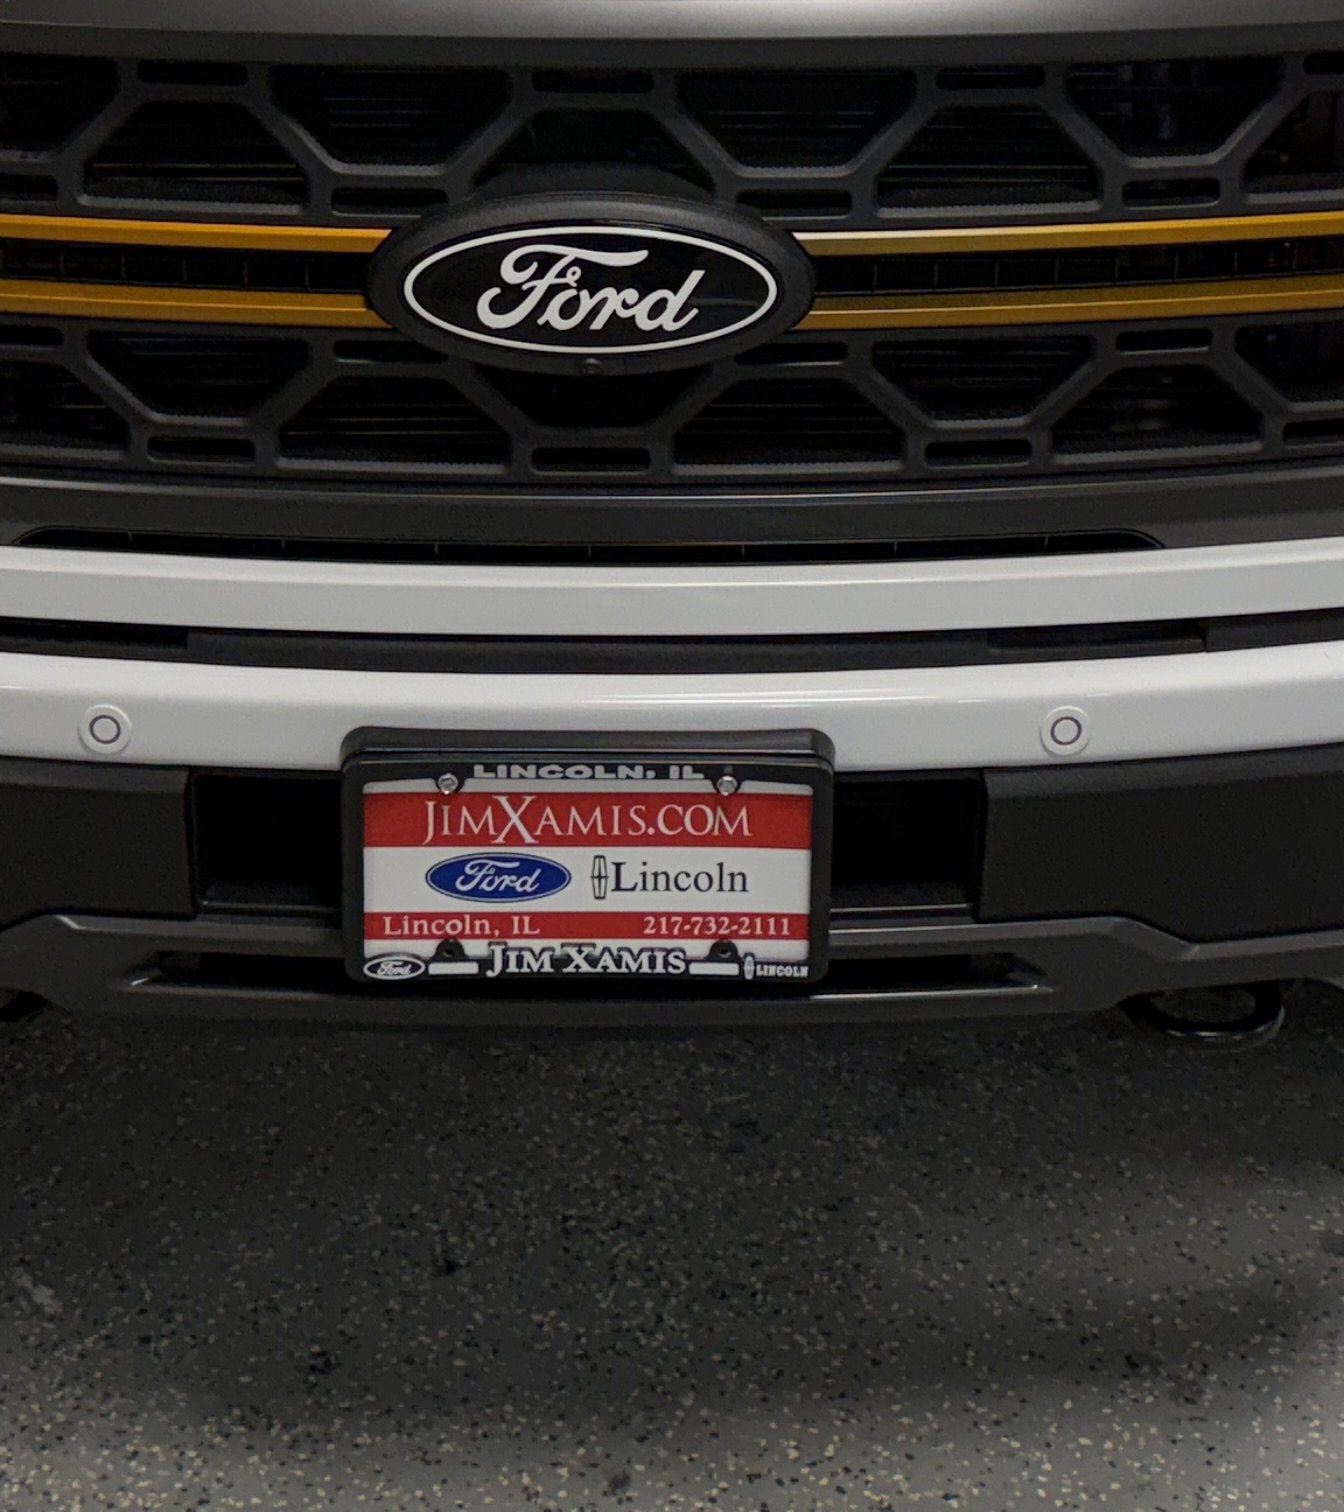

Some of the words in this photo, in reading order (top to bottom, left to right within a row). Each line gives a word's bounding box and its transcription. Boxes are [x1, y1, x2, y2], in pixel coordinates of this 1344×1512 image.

[476, 244, 706, 332] Ford
[669, 765, 705, 779] IL
[422, 795, 753, 845] JIMXAMIS.COM
[455, 860, 541, 893] Ford
[611, 861, 749, 893] Lincoln
[383, 915, 501, 938] Lincoln,
[512, 916, 541, 935] IL
[643, 917, 791, 936] 217-732-2111
[485, 944, 555, 978] JIM
[561, 944, 687, 975] XAMIS
[756, 963, 809, 978] LINCOLN
